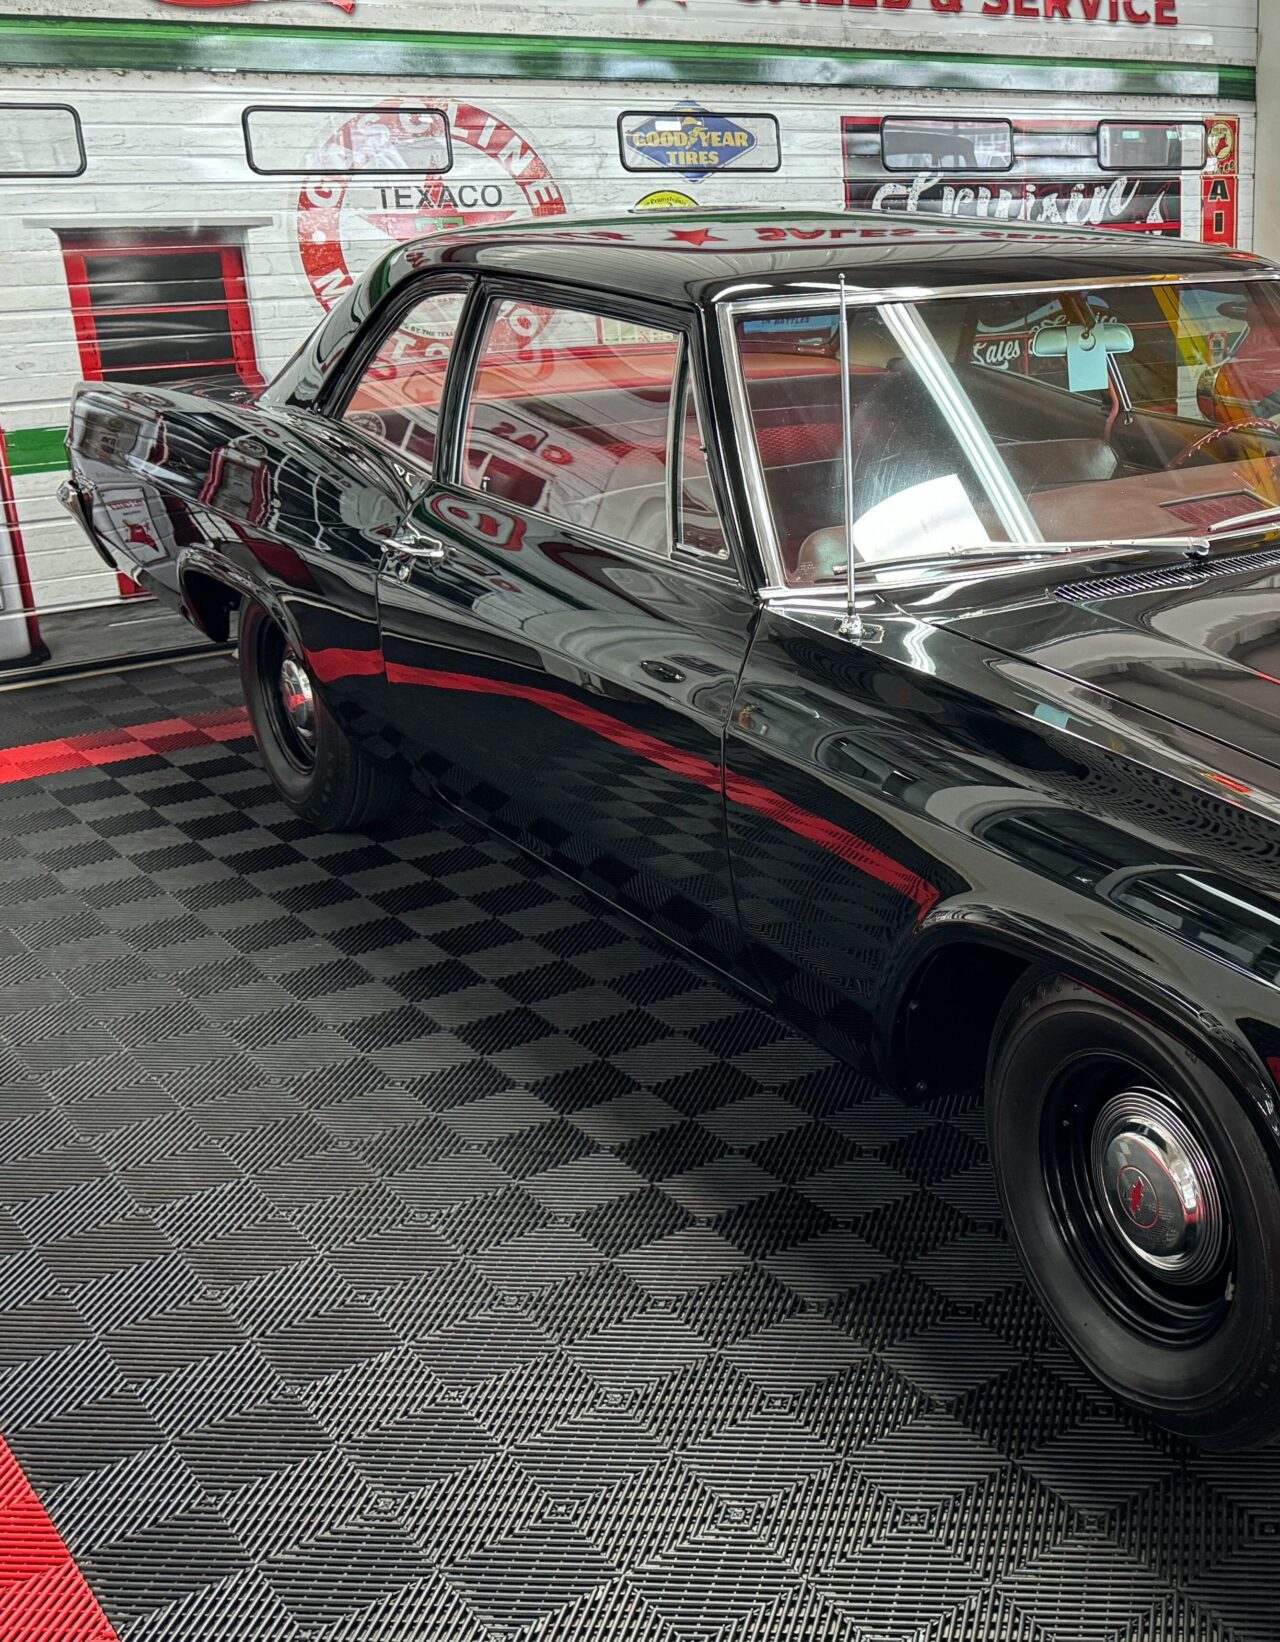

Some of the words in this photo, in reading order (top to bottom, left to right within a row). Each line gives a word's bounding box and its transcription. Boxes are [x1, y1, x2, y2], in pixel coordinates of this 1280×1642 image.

[632, 131, 749, 148] GOODYEAR
[667, 151, 719, 166] TIRES
[372, 185, 503, 210] TEXACO
[1207, 178, 1232, 247] AI
